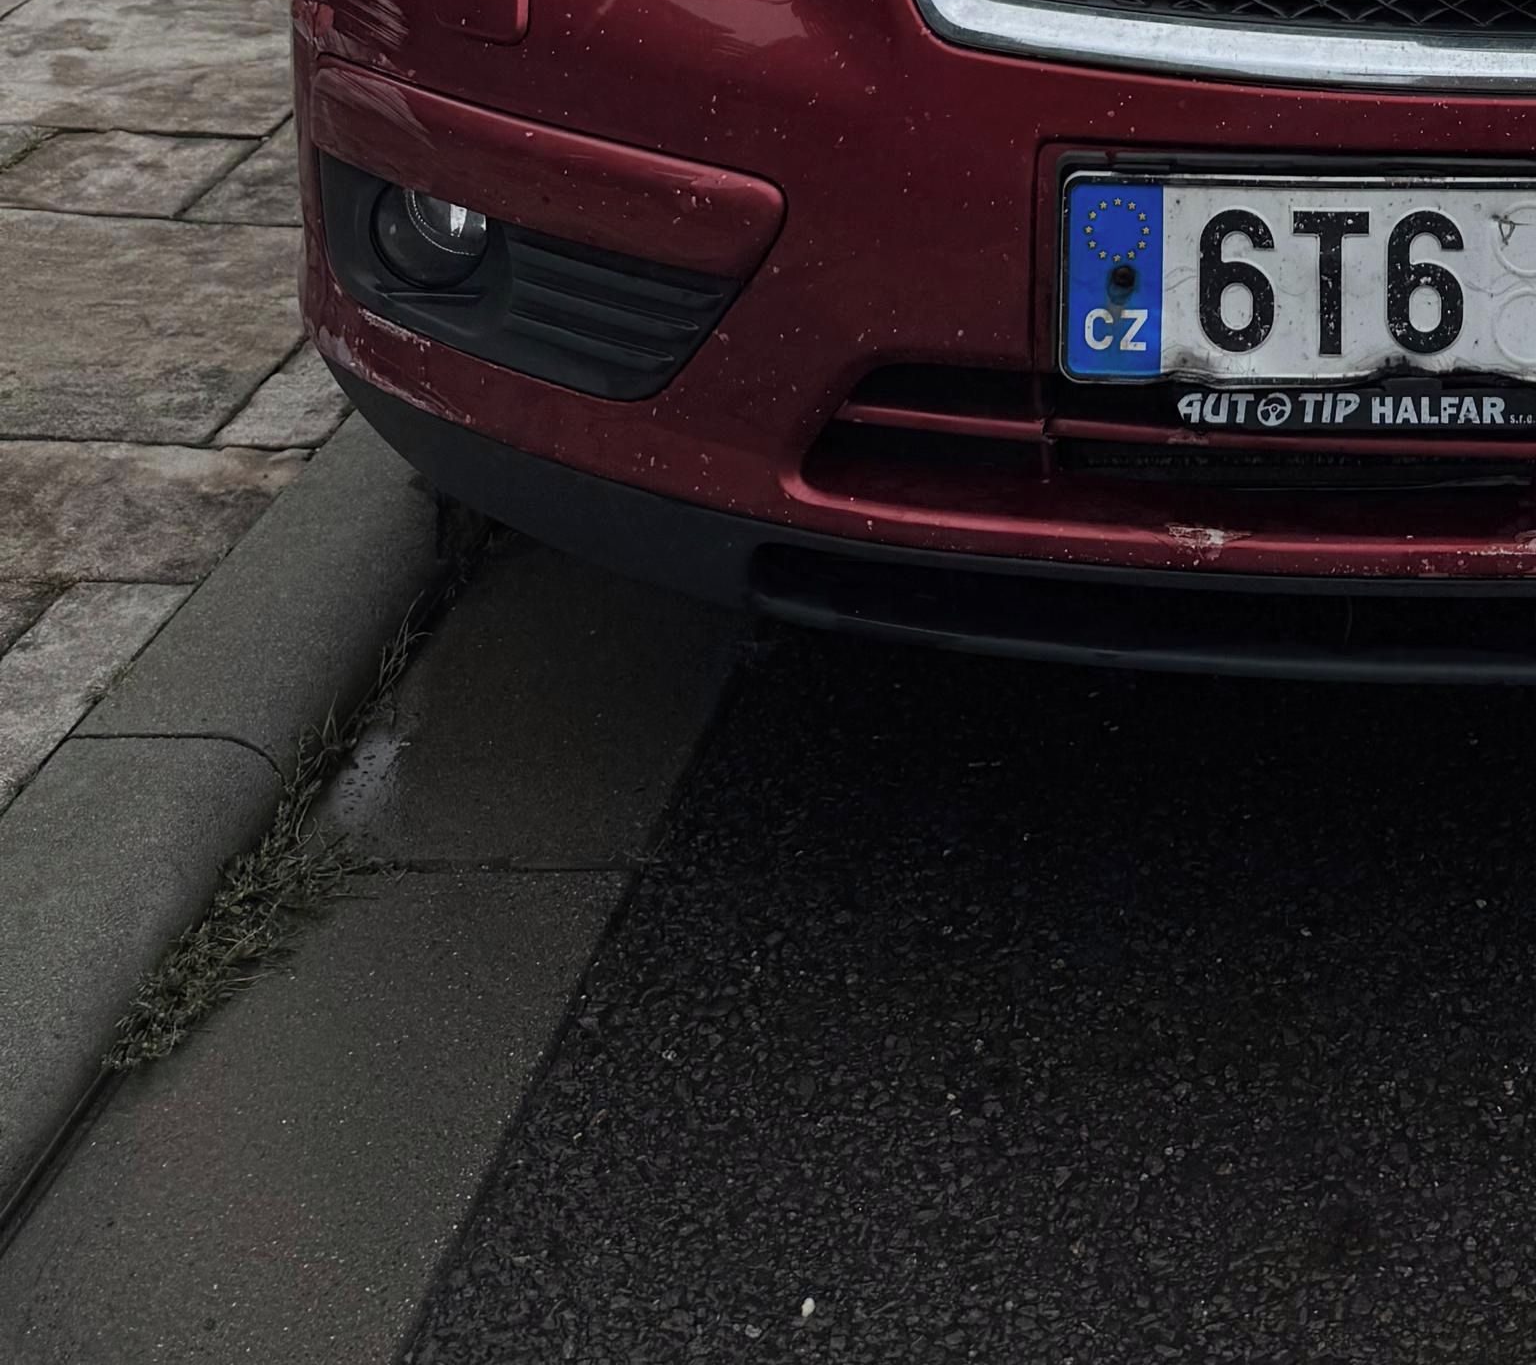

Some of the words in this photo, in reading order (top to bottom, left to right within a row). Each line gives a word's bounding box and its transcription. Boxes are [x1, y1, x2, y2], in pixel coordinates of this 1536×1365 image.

[1199, 205, 1465, 356] 6T6
[1084, 308, 1149, 352] CZ
[1298, 392, 1361, 425] TIP
[1370, 395, 1506, 425] HALFAR
